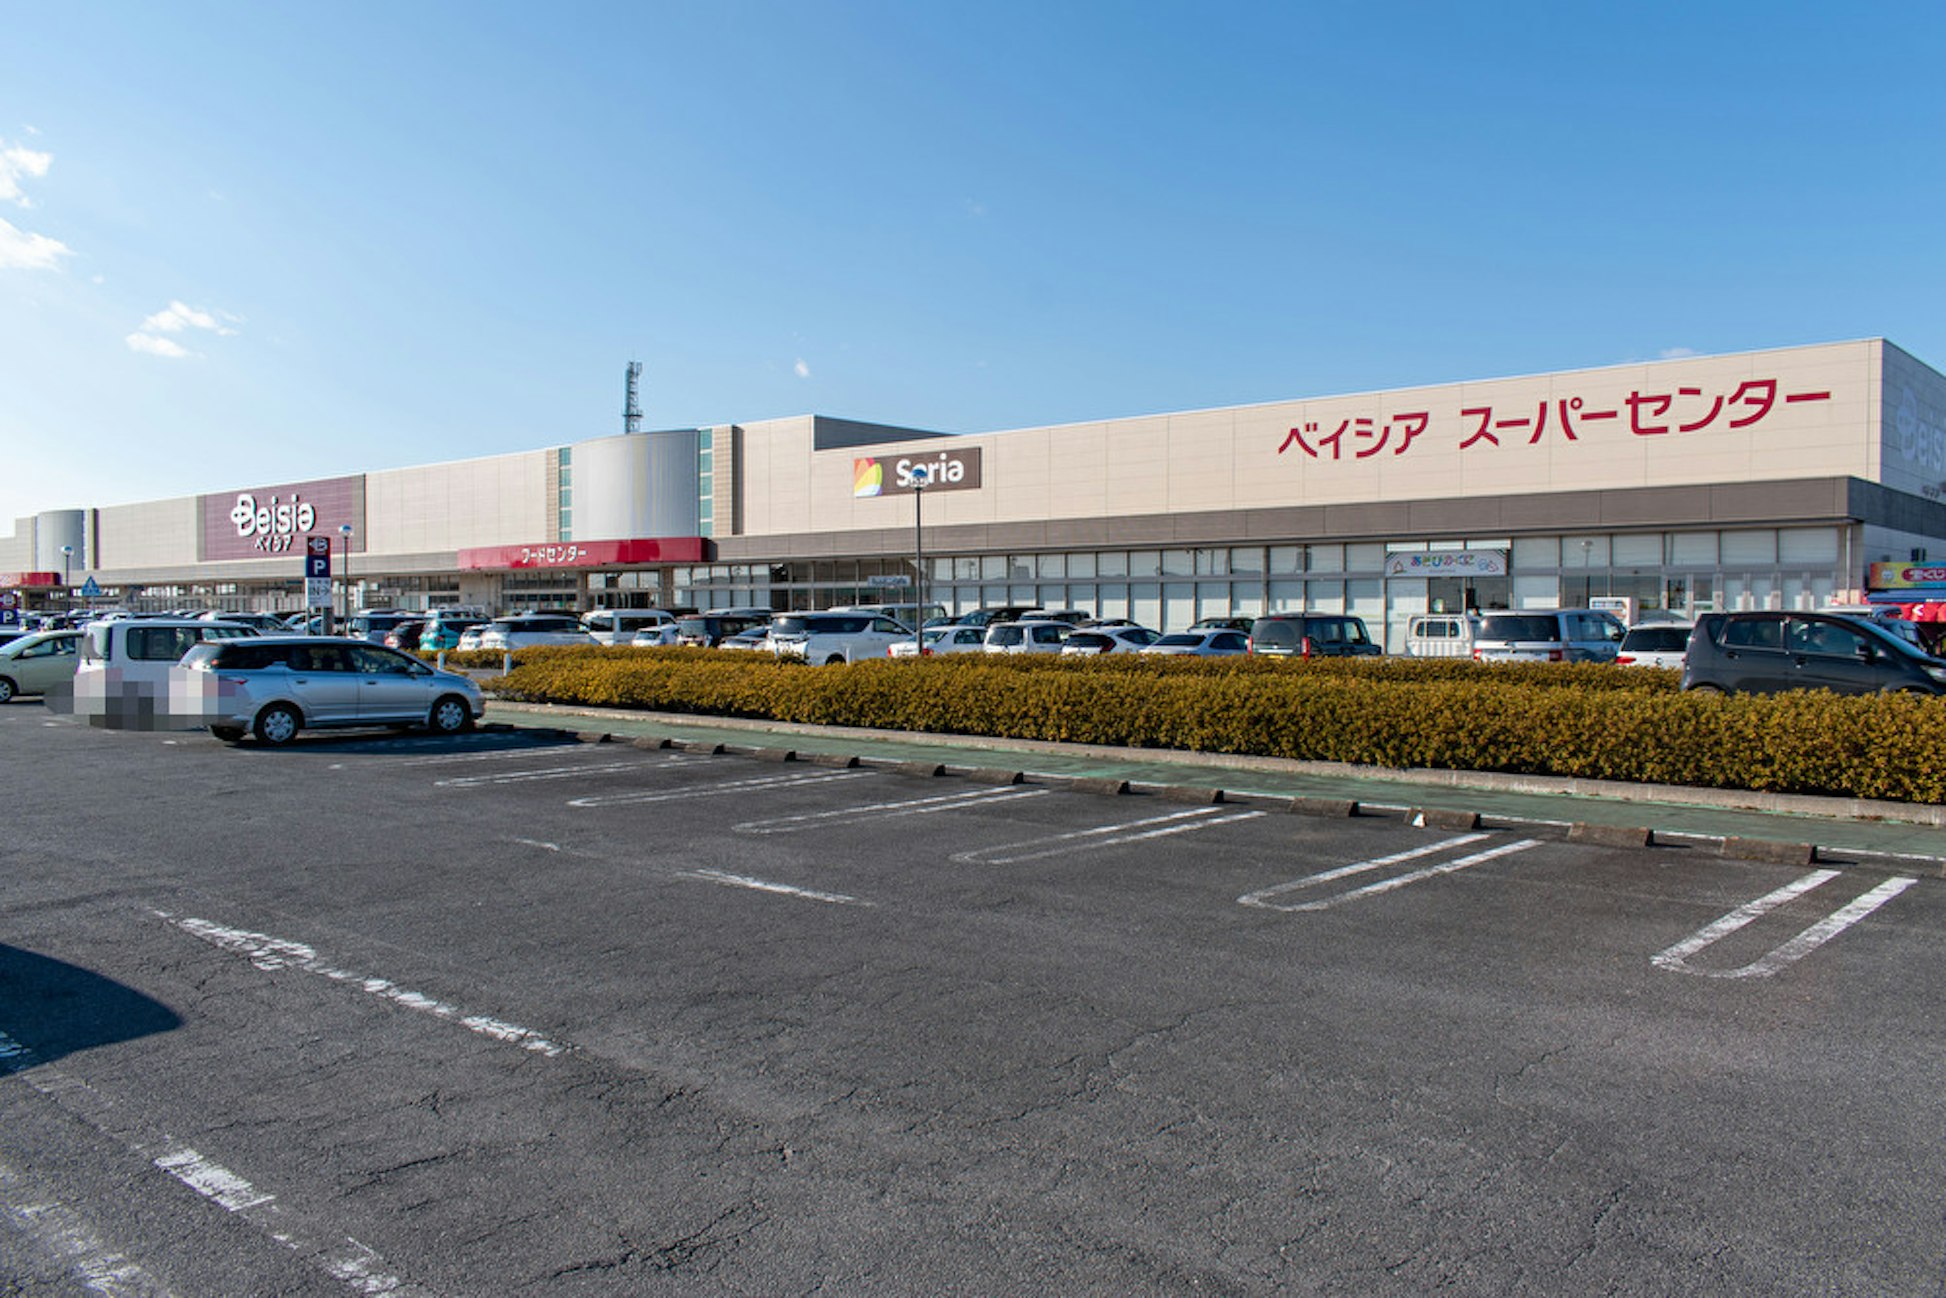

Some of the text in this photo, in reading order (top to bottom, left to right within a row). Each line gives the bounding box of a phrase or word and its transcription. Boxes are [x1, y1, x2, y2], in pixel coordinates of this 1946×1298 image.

[1278, 379, 1830, 459] ベイシア スーパーセンター
[231, 494, 316, 536] Beisia
[521, 546, 587, 564] フードセンター
[313, 560, 326, 575] P
[3, 610, 14, 624] P
